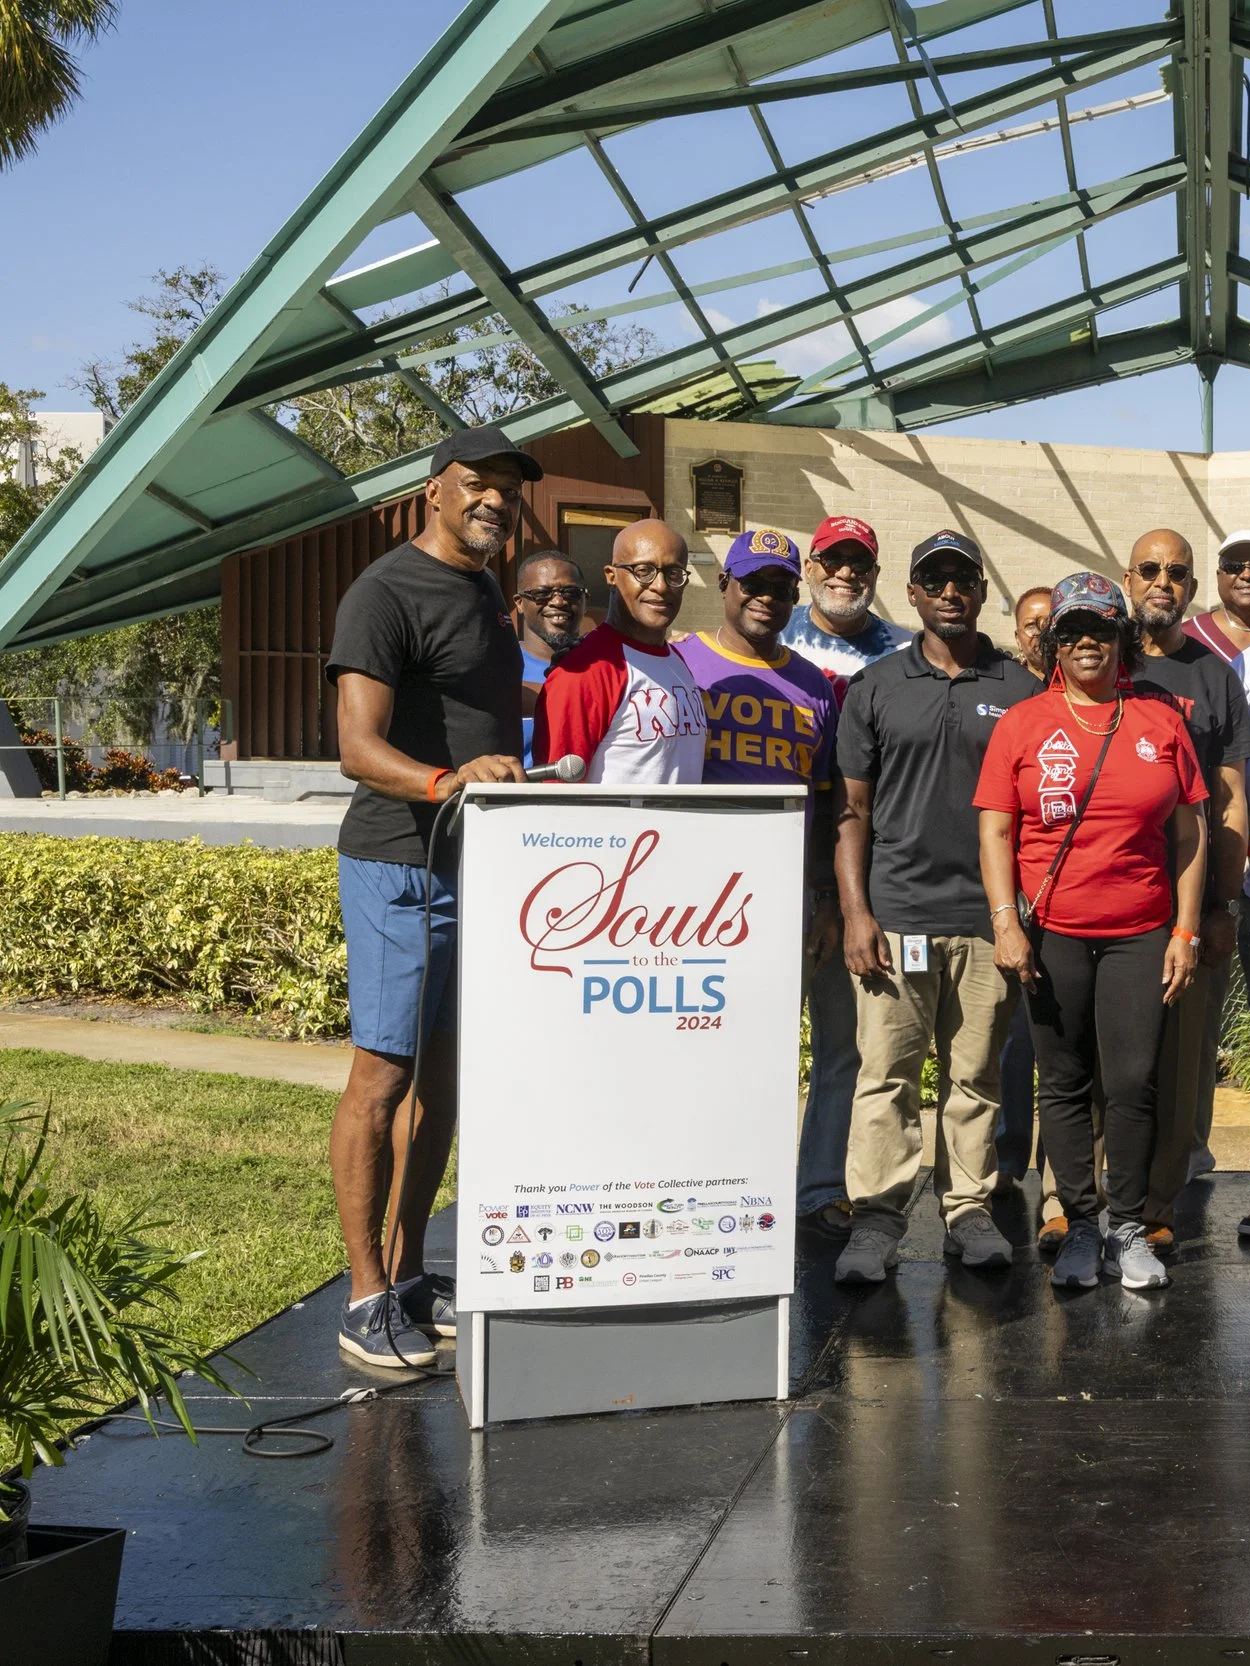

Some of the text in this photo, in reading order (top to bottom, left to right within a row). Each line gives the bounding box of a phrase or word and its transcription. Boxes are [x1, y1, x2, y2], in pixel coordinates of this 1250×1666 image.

[764, 537, 777, 546] 92
[701, 691, 816, 738] VOTE
[521, 832, 627, 849] Welcome to
[519, 829, 753, 978] Souls
[633, 953, 678, 967] to the
[583, 975, 726, 1014] POLLS
[676, 1016, 723, 1030] 2024
[514, 1177, 748, 1194] Thank you Power of the Vote Collective partners:
[614, 1201, 653, 1209] WOODSON
[741, 1195, 773, 1206] NBNA
[485, 1211, 508, 1219] vote
[556, 1203, 595, 1214] NCNW
[693, 1248, 720, 1256] NAACP
[711, 1268, 735, 1281] SPC
[555, 1276, 574, 1289] PB
